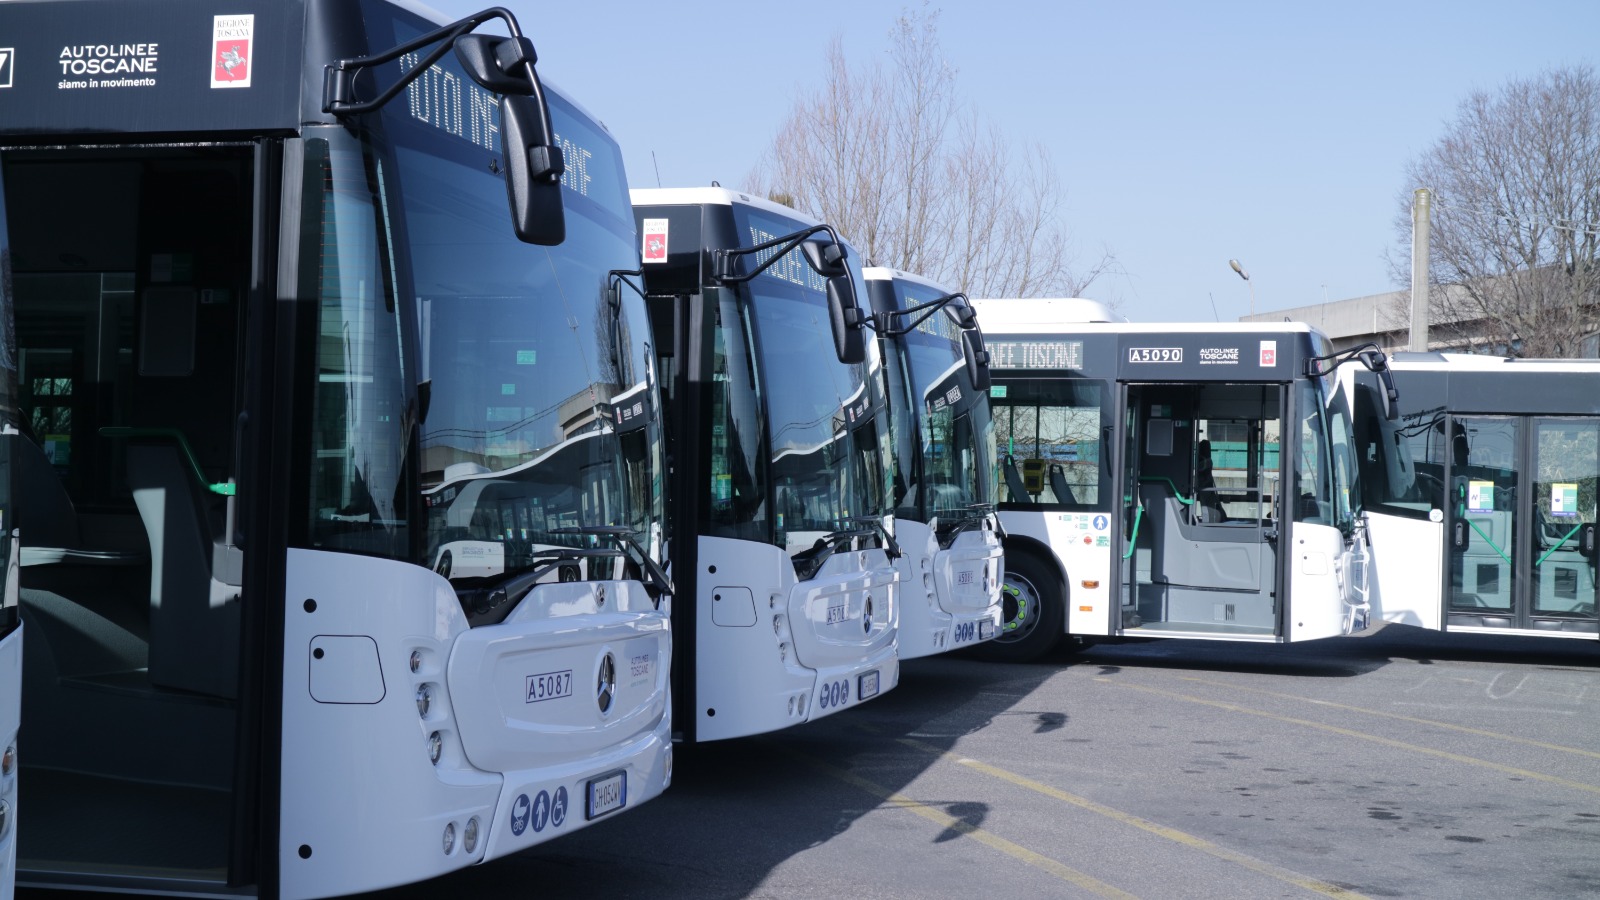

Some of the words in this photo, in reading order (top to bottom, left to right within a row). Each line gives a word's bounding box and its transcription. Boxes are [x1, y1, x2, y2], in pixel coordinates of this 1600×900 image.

[60, 43, 158, 58] AUTOLINEE
[59, 57, 157, 75] TOSCANE
[58, 79, 87, 89] siamo
[89, 78, 99, 88] in
[100, 77, 156, 88] movimento
[1021, 342, 1081, 369] TOSCANE
[1131, 349, 1180, 361] A5090
[528, 673, 571, 700] A5087
